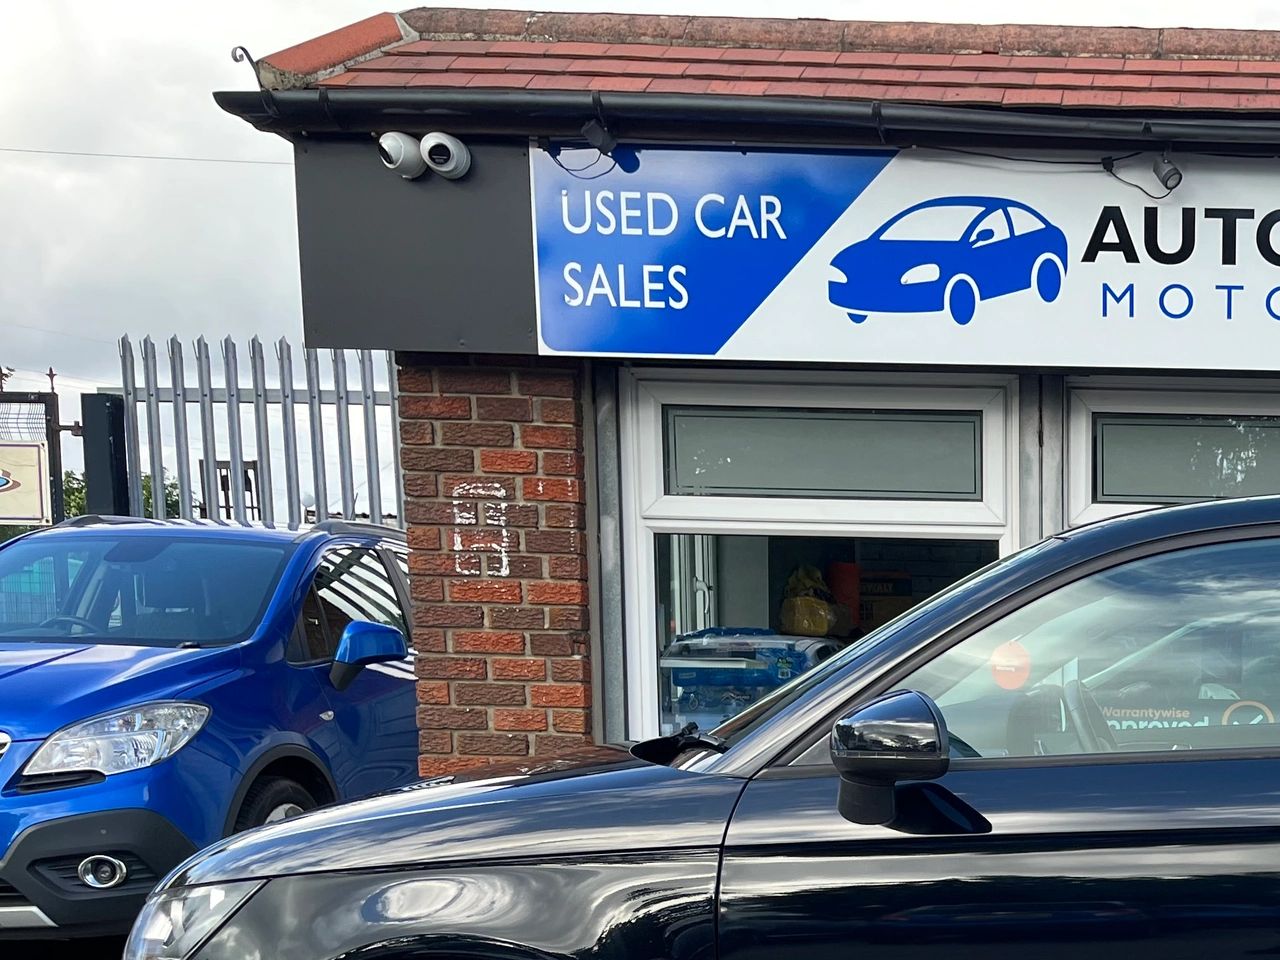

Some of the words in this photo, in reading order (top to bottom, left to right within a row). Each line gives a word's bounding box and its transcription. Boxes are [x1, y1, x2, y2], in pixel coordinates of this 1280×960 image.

[561, 190, 677, 236] USED
[695, 193, 787, 240] CAR
[563, 262, 689, 310] SALES
[1101, 706, 1191, 719] Warrantywise
